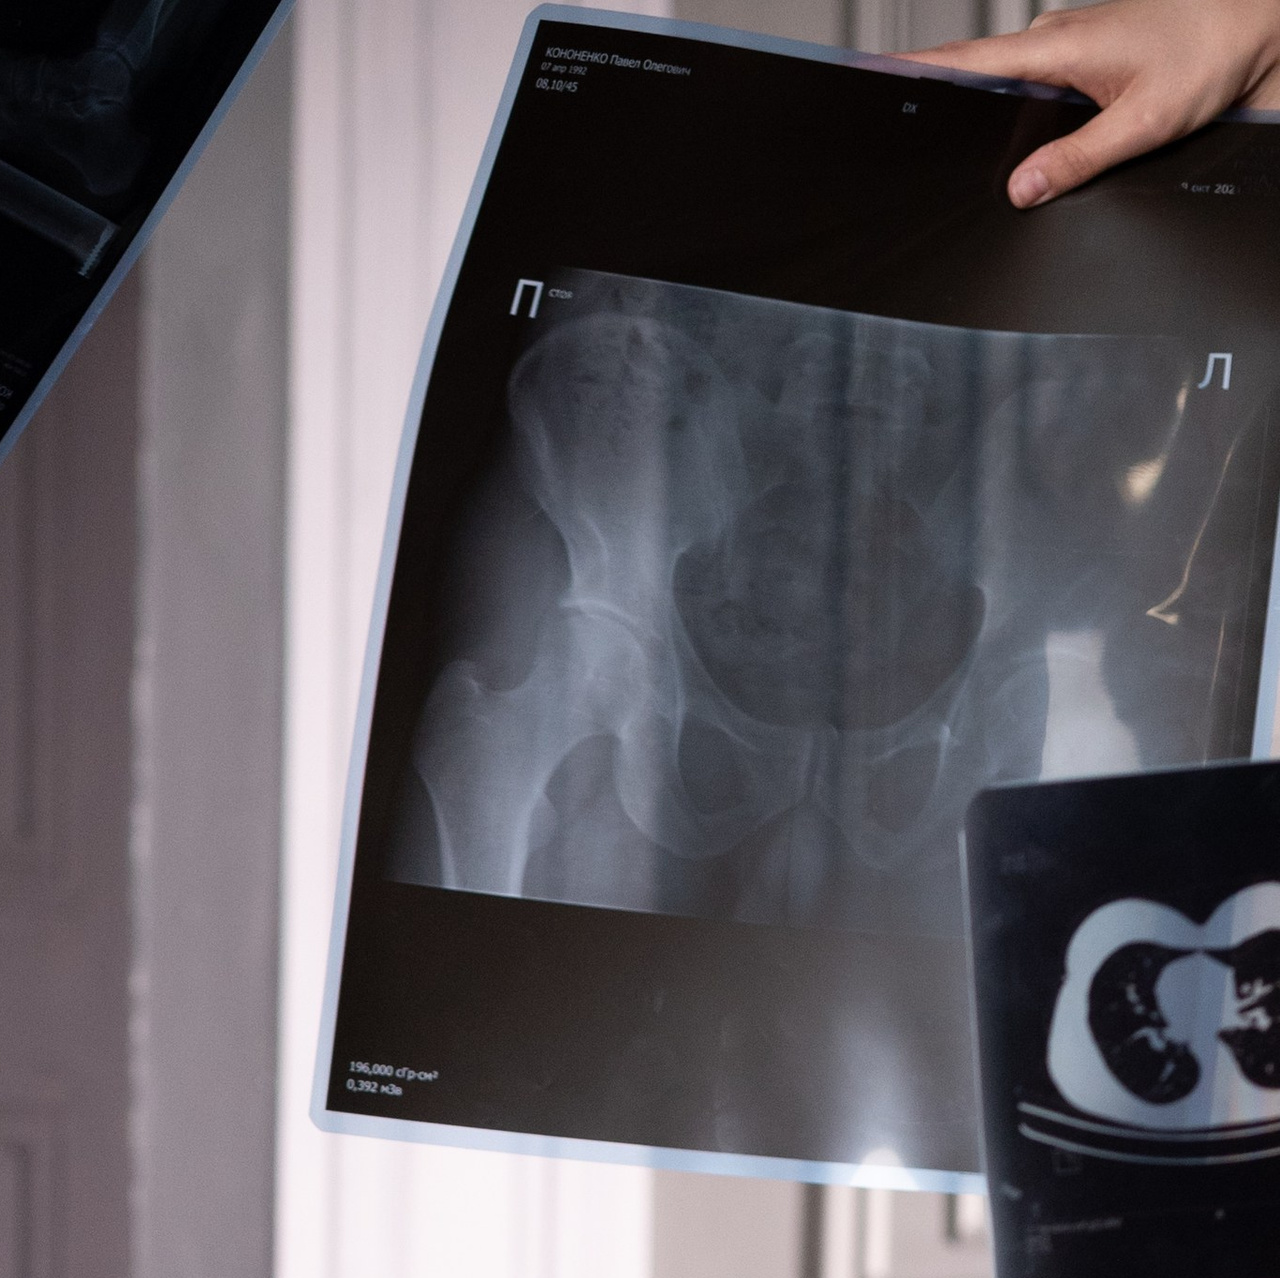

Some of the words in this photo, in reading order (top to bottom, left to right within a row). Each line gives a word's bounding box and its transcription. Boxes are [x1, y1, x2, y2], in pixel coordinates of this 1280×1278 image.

[545, 46, 608, 65] КОНОНЕНКО
[609, 55, 641, 69] Павел
[642, 58, 692, 76] Олегович
[902, 102, 918, 114] DX
[509, 278, 545, 319] П
[1197, 352, 1233, 390] Л
